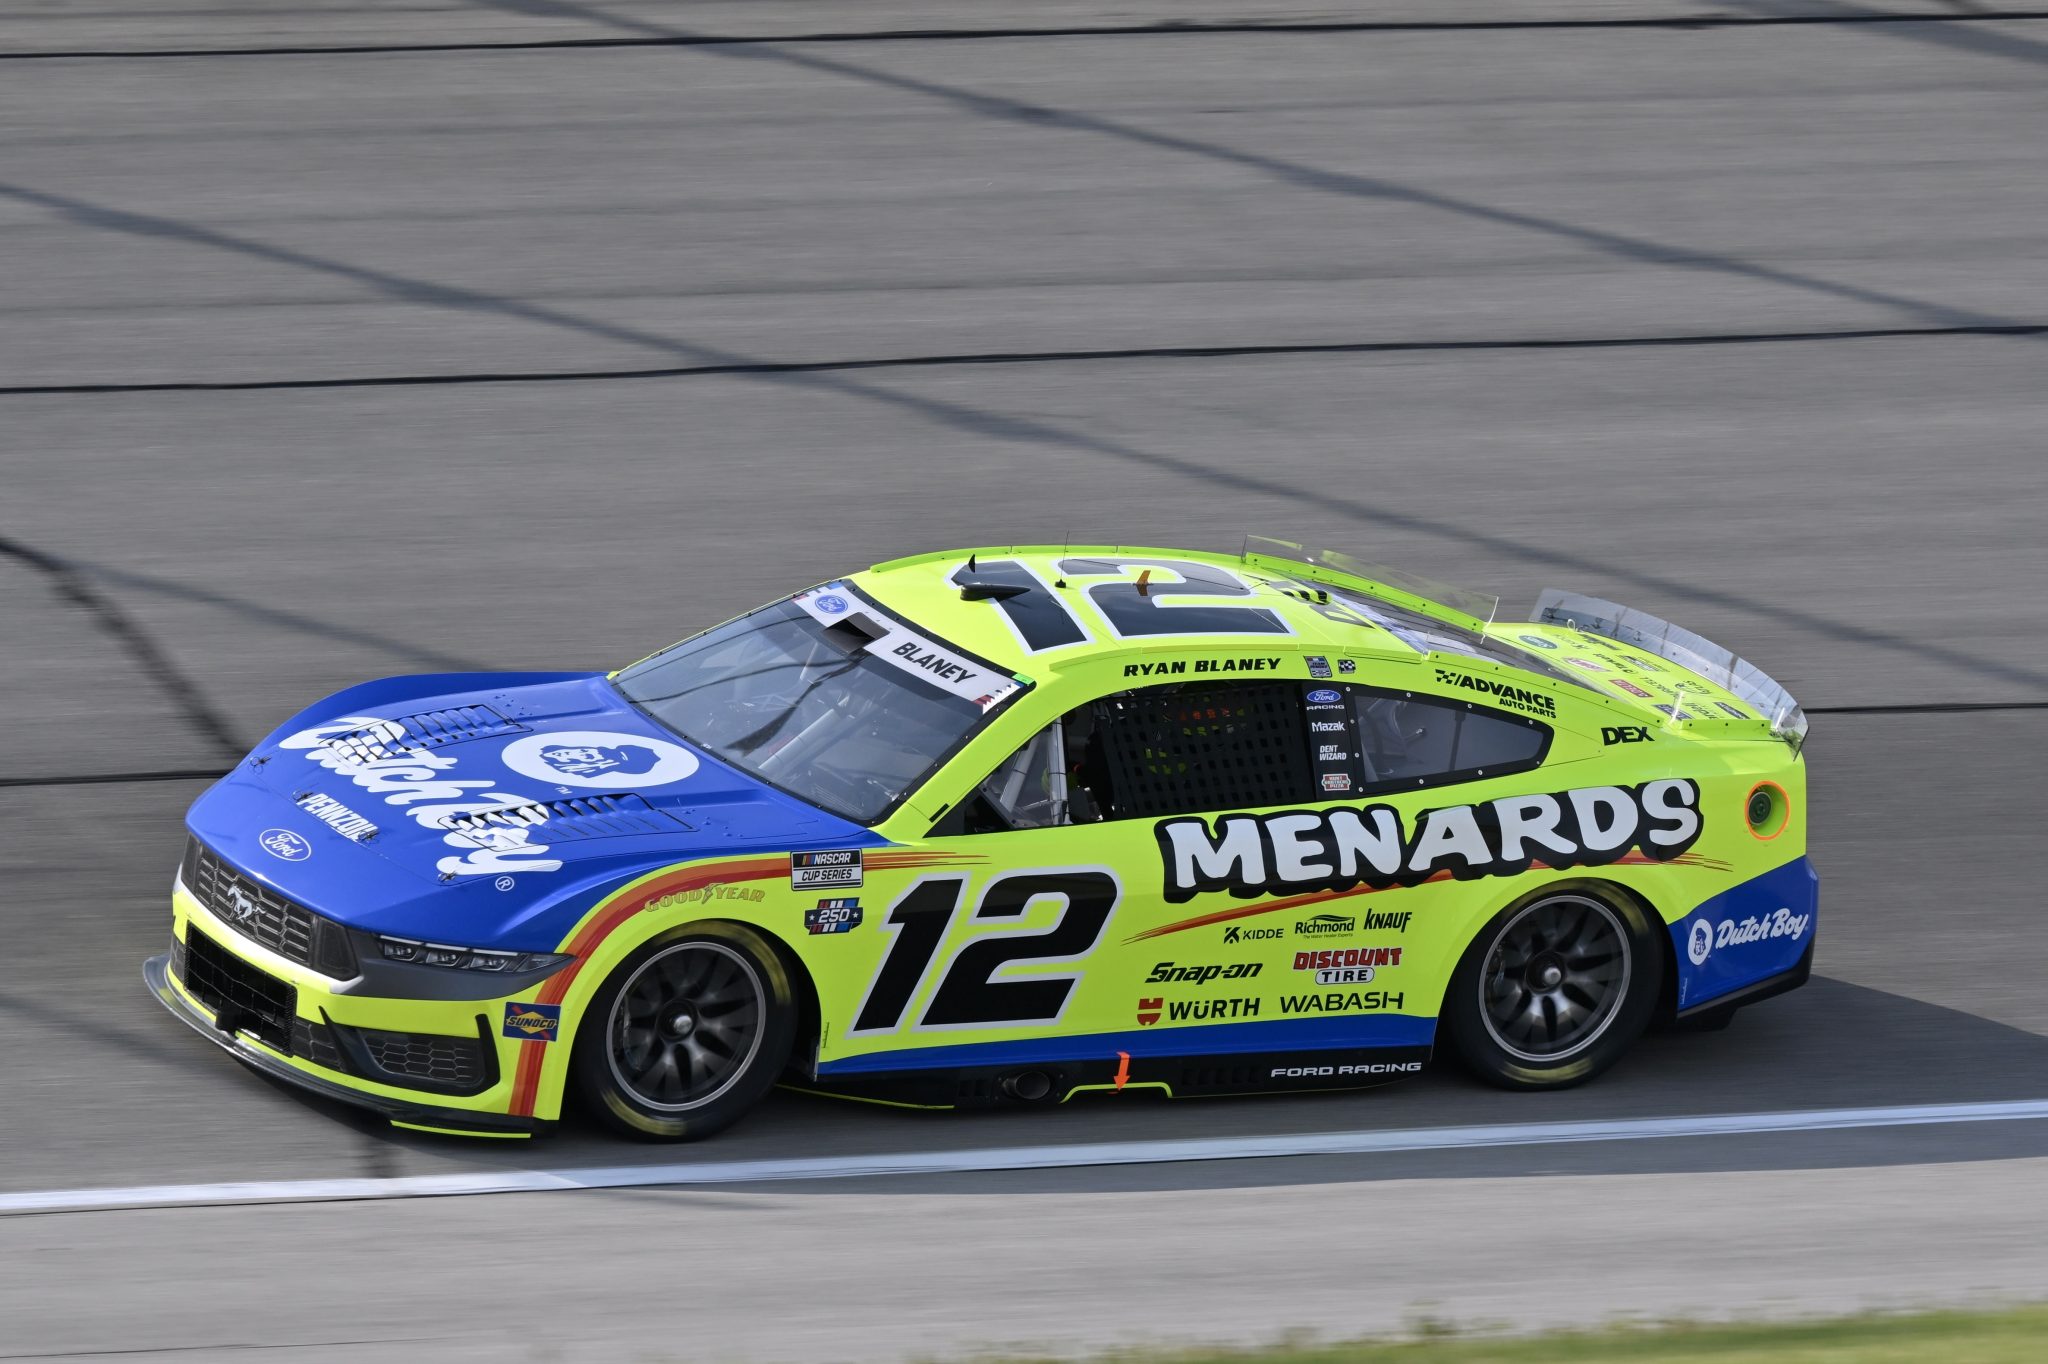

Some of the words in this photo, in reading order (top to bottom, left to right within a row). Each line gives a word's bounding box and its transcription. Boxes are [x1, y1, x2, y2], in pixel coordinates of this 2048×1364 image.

[946, 557, 1296, 654] 12
[892, 642, 977, 684] BLANEY
[1123, 660, 1186, 677] RYAN
[1194, 658, 1281, 673] BLANEY
[1311, 691, 1337, 702] Ford
[1459, 676, 1556, 711] ADVANCE
[1499, 699, 1526, 710] AUTO
[1526, 705, 1557, 719] PARTS
[1311, 721, 1346, 732] Mazak
[1601, 726, 1655, 746] DEX
[1320, 745, 1339, 753] DENT
[1320, 752, 1347, 761] WIZARD
[279, 717, 496, 805] Dutch
[405, 793, 563, 875] Boy
[263, 832, 307, 859] Ford
[1159, 778, 1701, 895] MENARDS
[814, 852, 851, 864] NASCAR
[801, 871, 821, 881] CUP
[821, 869, 852, 880] SERIES
[818, 909, 850, 923] 250
[1295, 916, 1355, 935] Richmond
[1243, 928, 1284, 940] KIDDE
[1715, 913, 1772, 949] Dutch
[1770, 908, 1809, 941] Boy
[847, 866, 1121, 1037] 12
[1293, 948, 1402, 970] DISCOUNT
[1144, 962, 1263, 985] Snap-on
[1321, 969, 1368, 982] TIRE
[1280, 991, 1404, 1014] WABASH
[507, 1015, 556, 1028] SUNOCO
[1271, 1065, 1334, 1077] FORD
[1338, 1062, 1422, 1075] RACING
